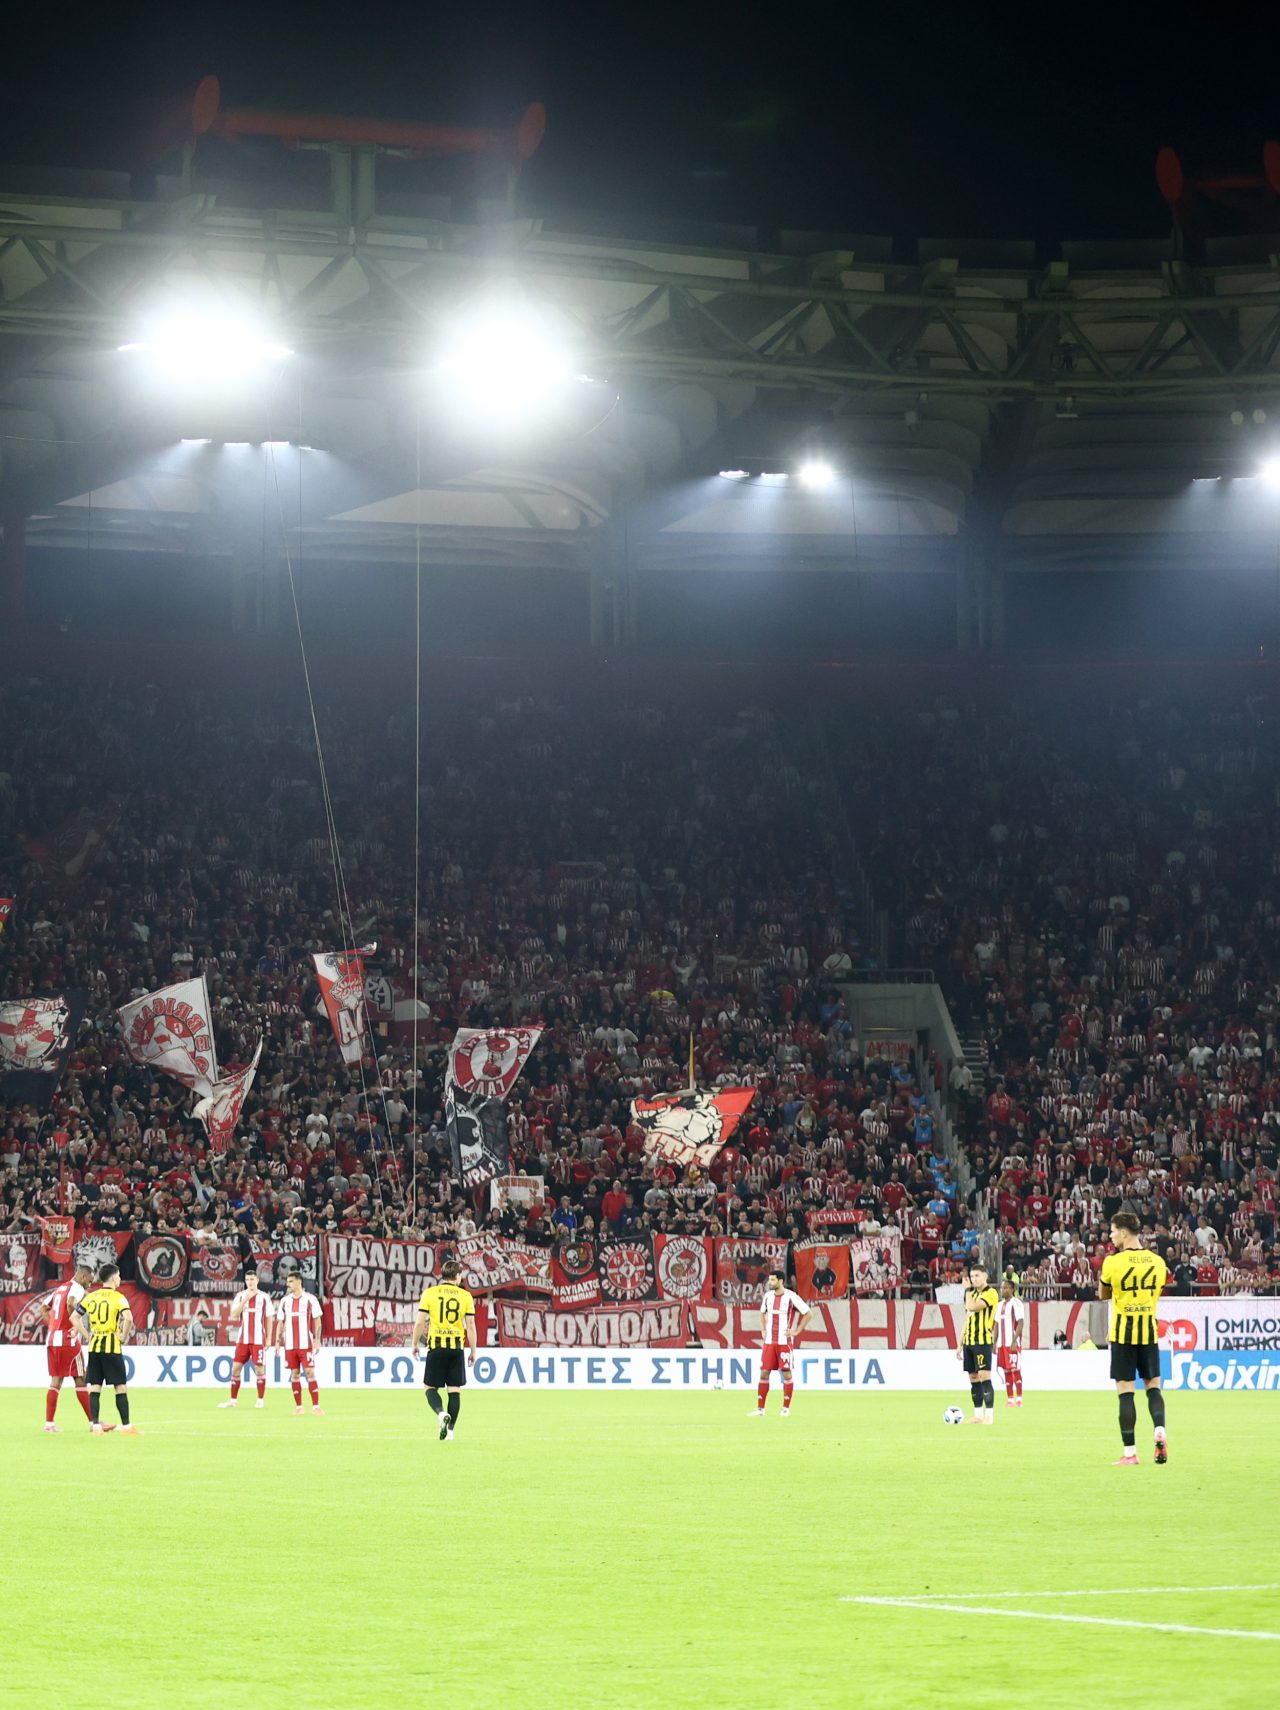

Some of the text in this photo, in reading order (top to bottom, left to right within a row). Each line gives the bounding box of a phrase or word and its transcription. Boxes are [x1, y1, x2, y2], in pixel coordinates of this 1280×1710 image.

[328, 1236, 436, 1275] ΠΑΛΑΙΟ
[719, 1242, 787, 1260] ΑΛΙΜΟΣ
[1121, 1265, 1157, 1297] 44
[87, 1300, 109, 1325] 20
[438, 1296, 460, 1325] 18
[503, 1305, 682, 1346] ΗΛΙΟΥΠΟΛΗ
[334, 1356, 632, 1384] ΠΡΩΘΛΗΤΕΣ
[651, 1358, 752, 1384] ΣΤΗΝ
[780, 1358, 886, 1384] ΓΕΙΑ
